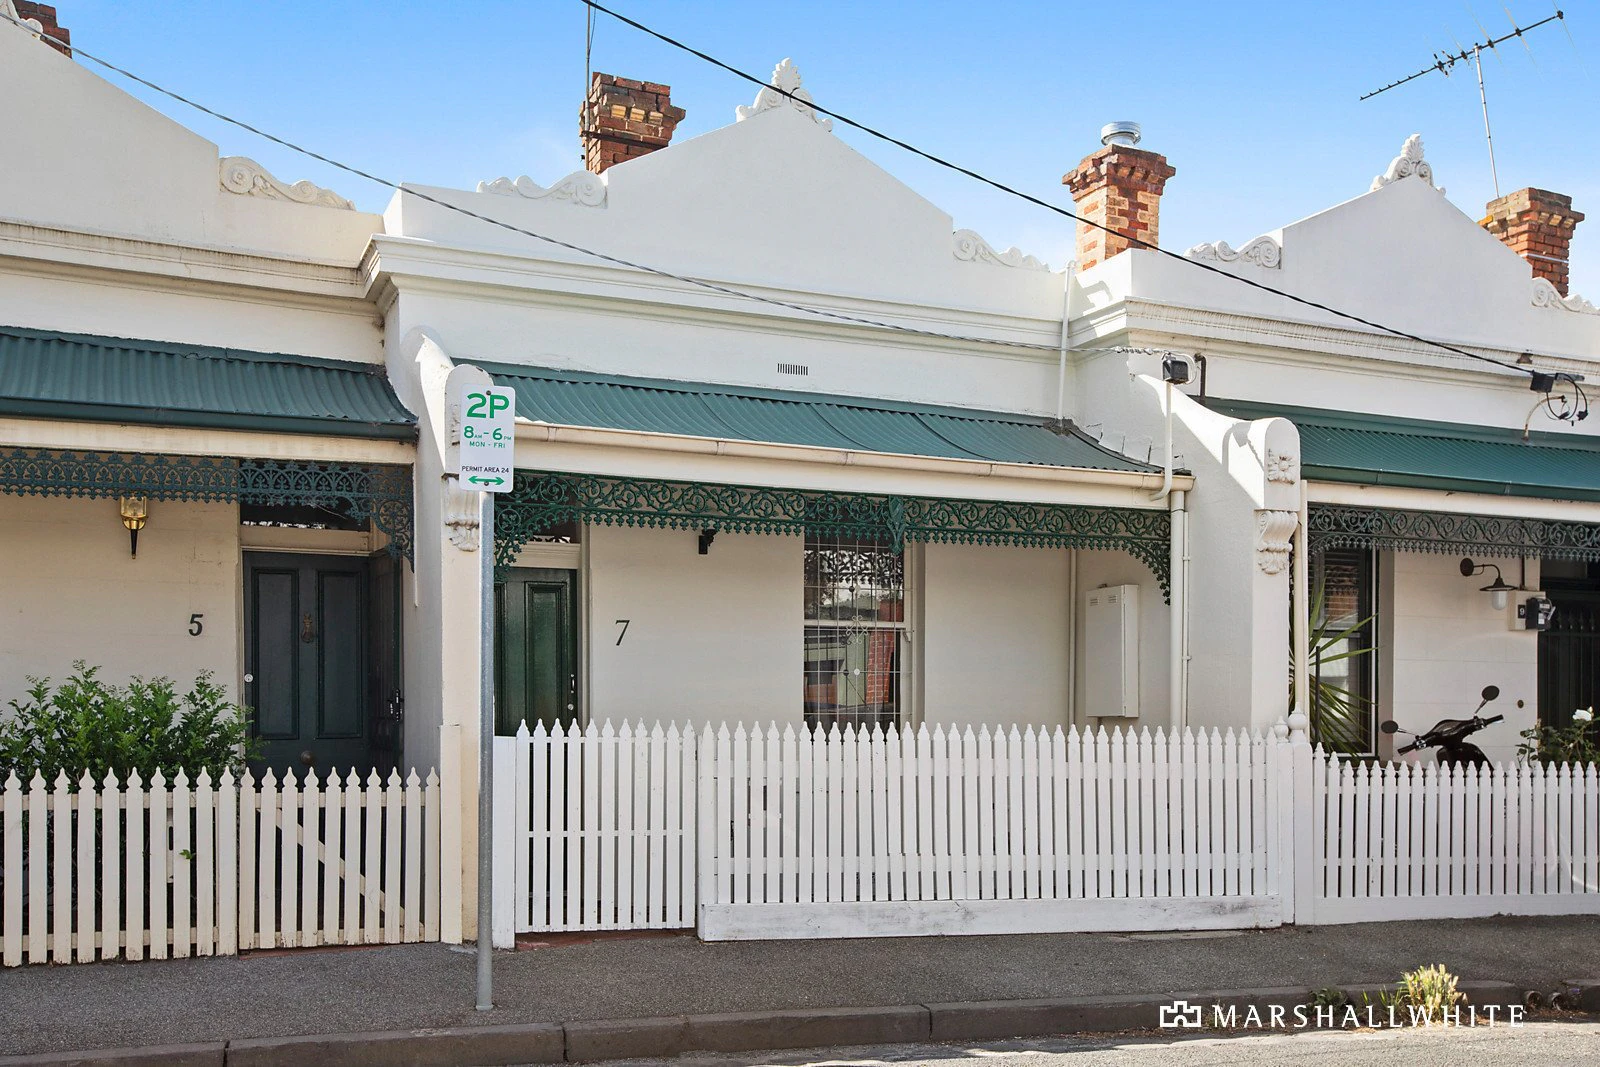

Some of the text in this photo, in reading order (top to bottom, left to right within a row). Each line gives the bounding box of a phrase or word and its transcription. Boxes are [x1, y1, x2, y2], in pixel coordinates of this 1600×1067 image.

[467, 393, 509, 418] 2P
[1519, 607, 1525, 615] 9
[185, 613, 204, 636] 5
[615, 619, 631, 646] 7
